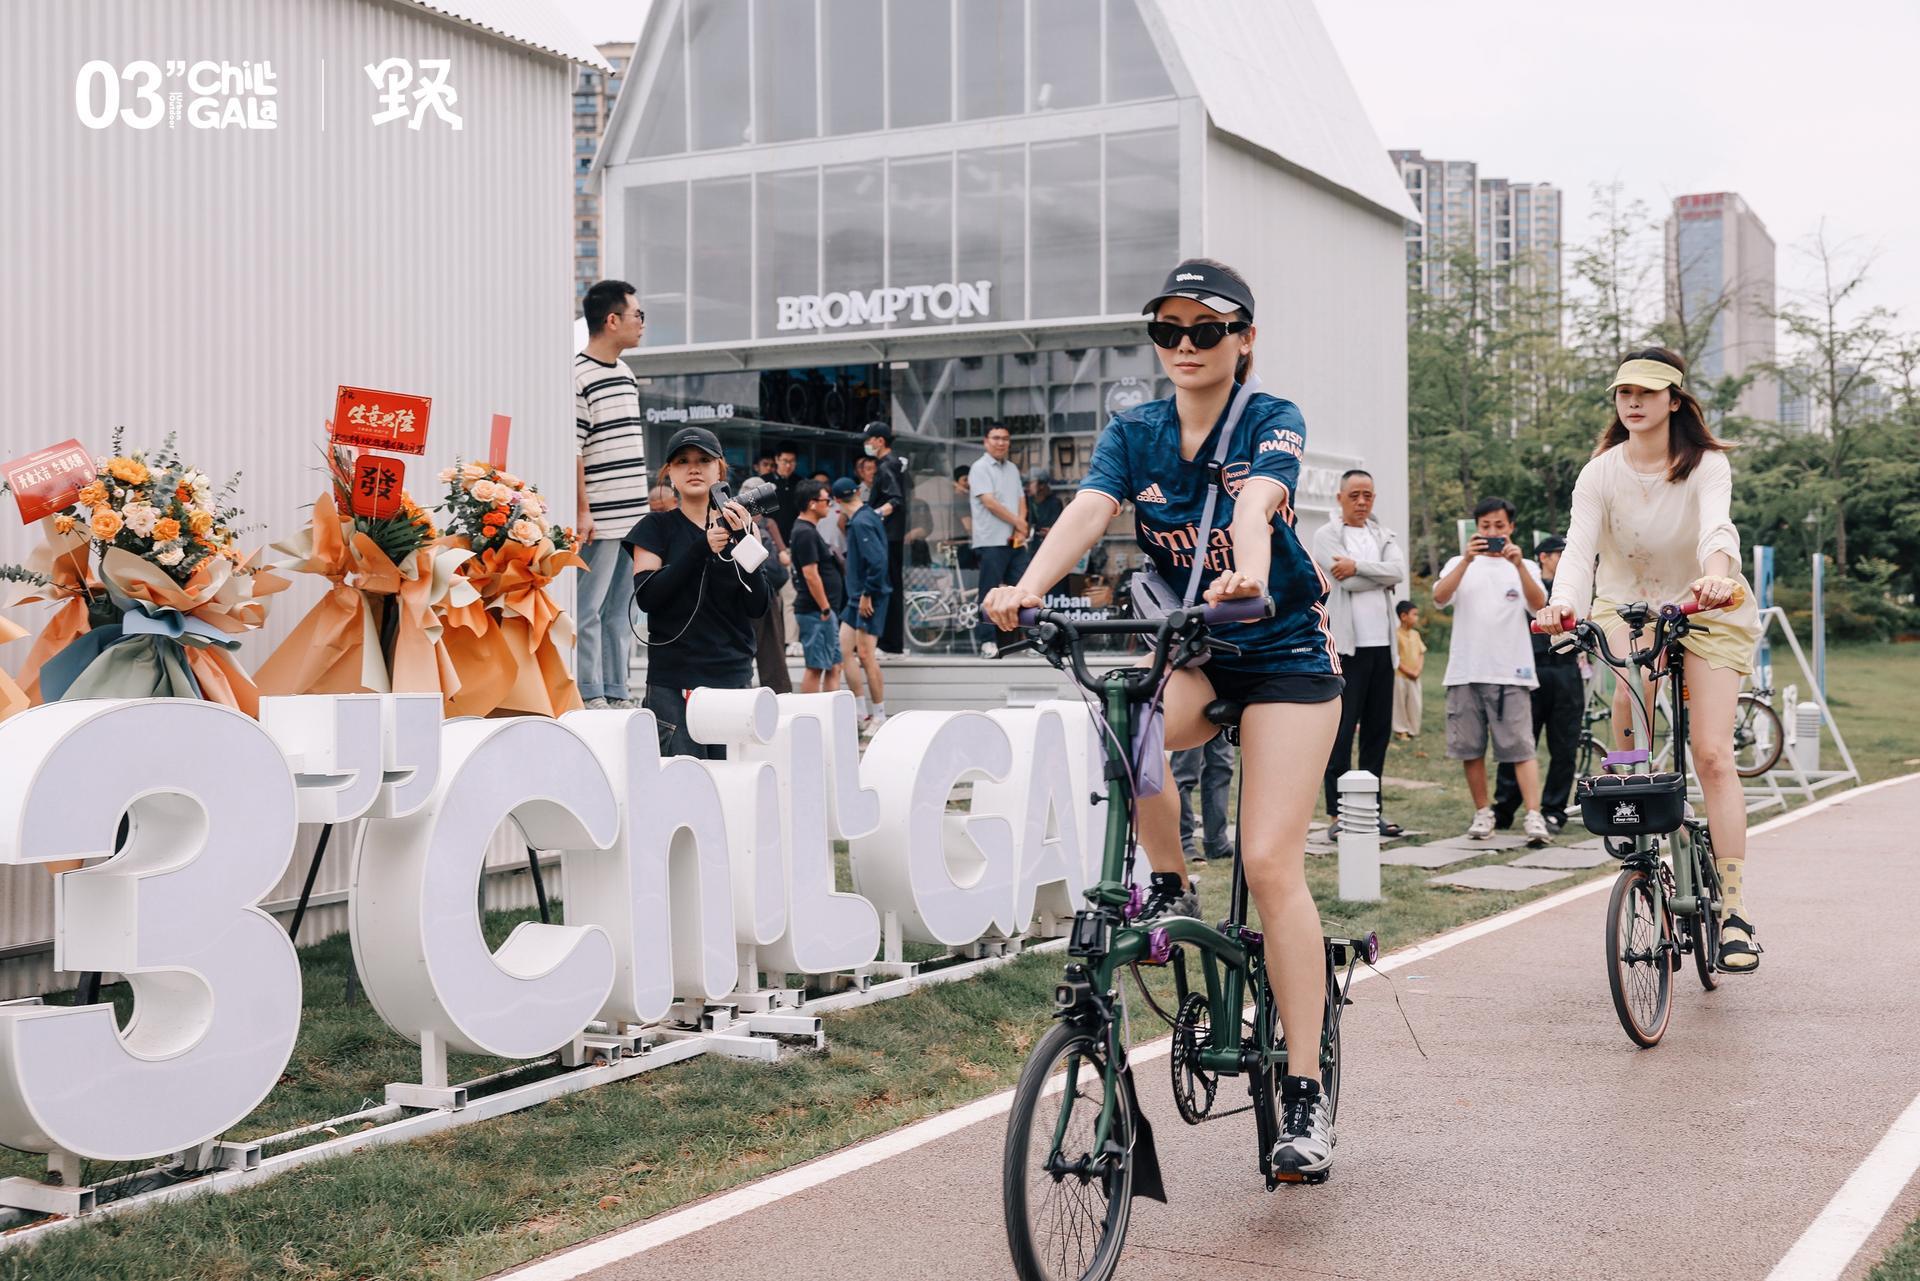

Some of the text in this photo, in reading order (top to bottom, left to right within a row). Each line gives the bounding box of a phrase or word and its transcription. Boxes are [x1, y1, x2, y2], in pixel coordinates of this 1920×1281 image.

[776, 280, 993, 331] BROMPTON
[646, 403, 734, 424] Cycling With 03
[1273, 429, 1304, 448] VISIT
[1259, 439, 1304, 463] RWAN
[1136, 495, 1167, 504] adidas
[1043, 594, 1091, 609] Urban
[1064, 608, 1111, 621] tdoor
